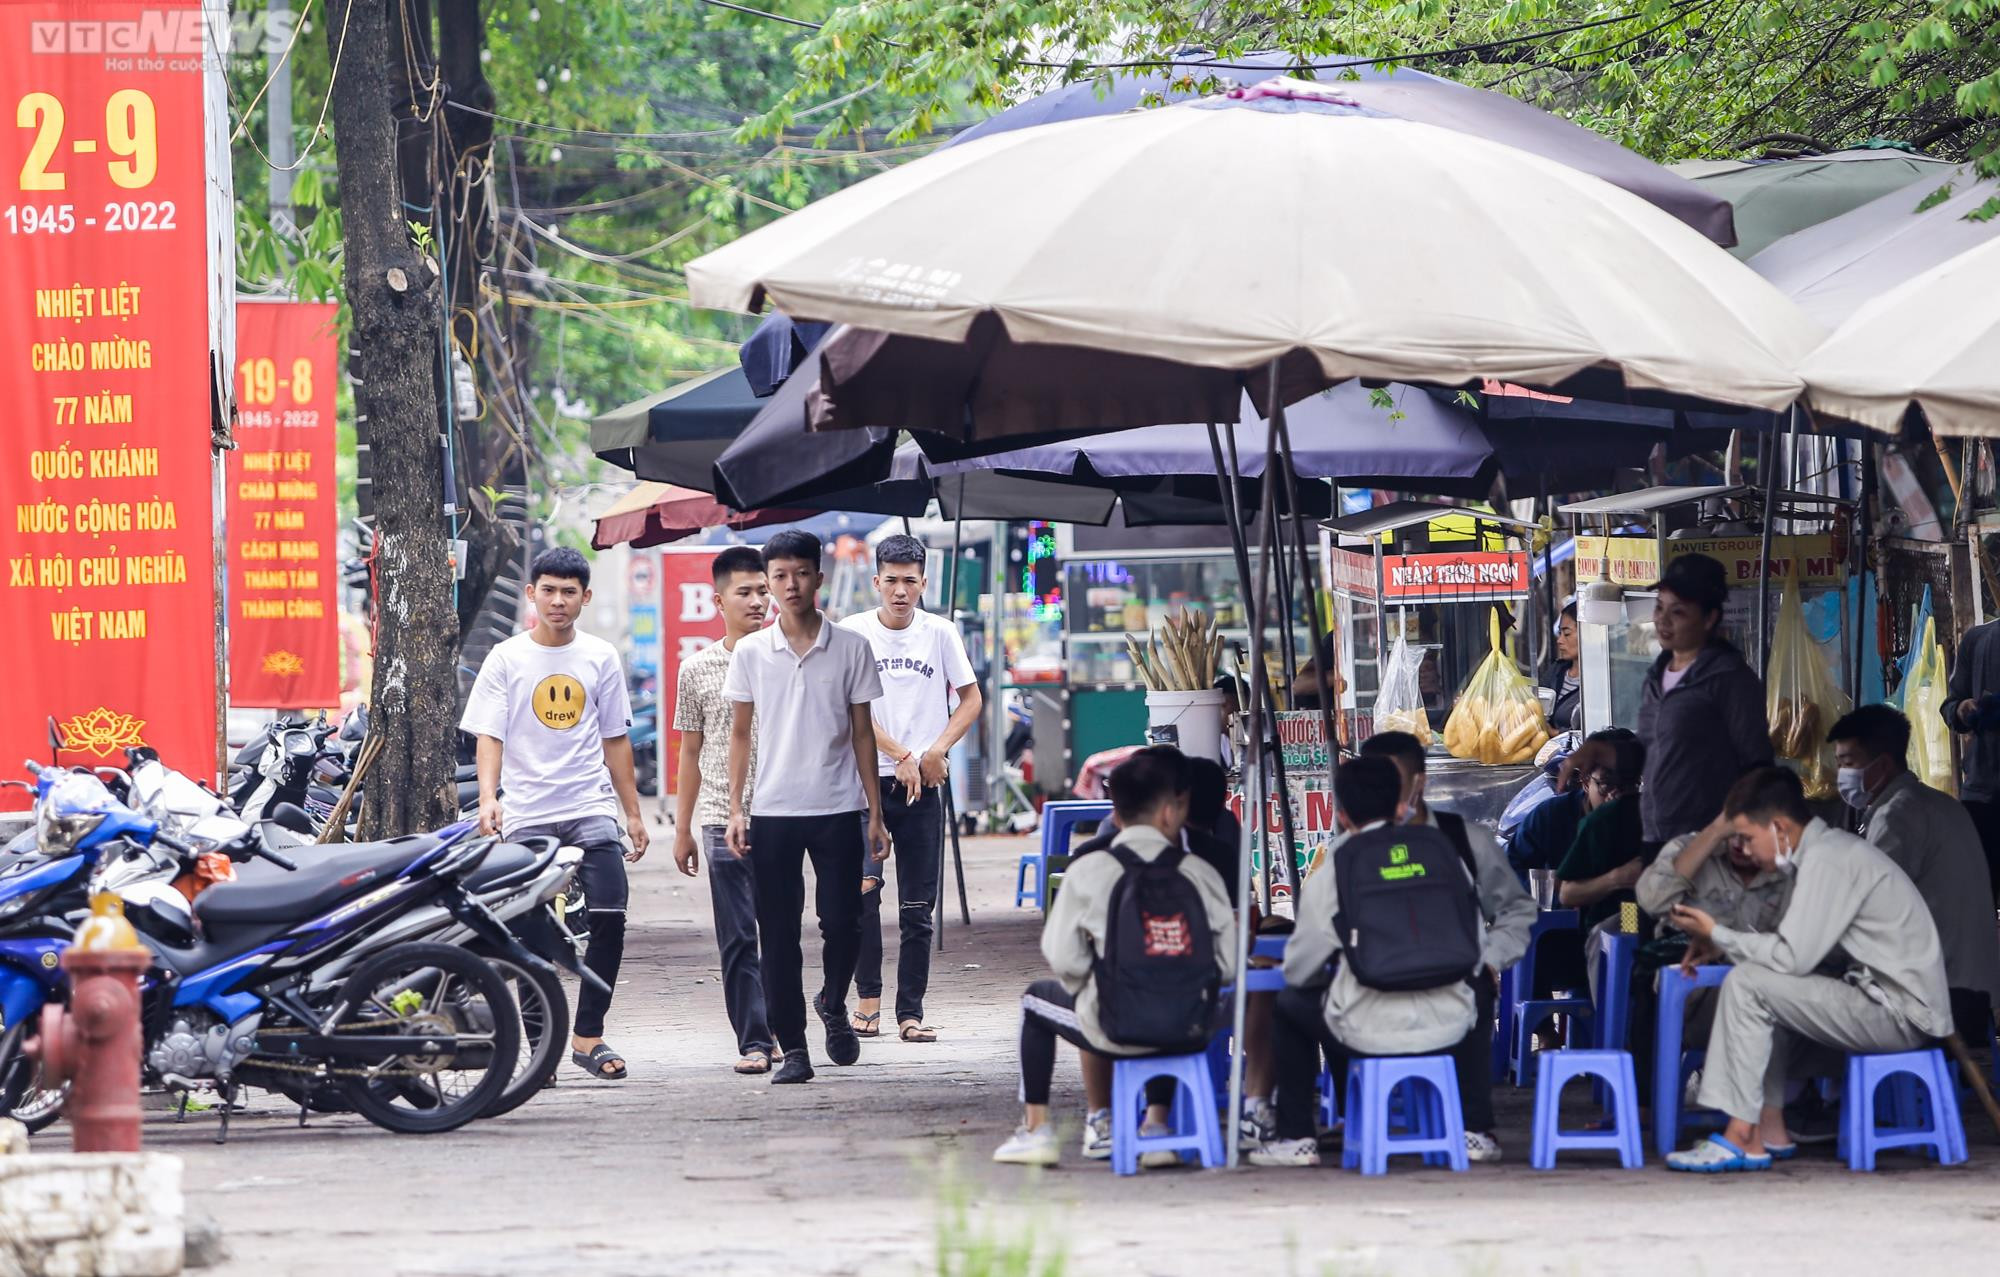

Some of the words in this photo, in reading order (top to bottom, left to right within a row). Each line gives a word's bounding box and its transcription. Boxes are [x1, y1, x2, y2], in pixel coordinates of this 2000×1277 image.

[4, 204, 75, 234] 1945
[105, 201, 176, 232] 2022
[36, 283, 94, 323] NHIỆT
[100, 281, 140, 321] LIỆT
[32, 337, 84, 372] CHÀO
[91, 334, 151, 369] MỪNG
[54, 397, 78, 425] 77
[85, 390, 132, 424] NĂM
[239, 410, 273, 427] 1945
[283, 410, 319, 428] 2022
[31, 440, 84, 481] QUỐC
[90, 443, 158, 477] KHÁNH
[17, 497, 69, 532] NƯỚC
[75, 500, 130, 539] CỘNG
[137, 496, 177, 531] HÒA
[254, 512, 271, 530] 77
[10, 553, 37, 587] XÃ
[40, 556, 73, 593] HỘI
[79, 545, 120, 587] CHỦ
[127, 550, 186, 585] NGHĨA
[51, 607, 95, 646] VIỆT
[100, 610, 146, 639] NAM
[545, 710, 576, 721] drew
